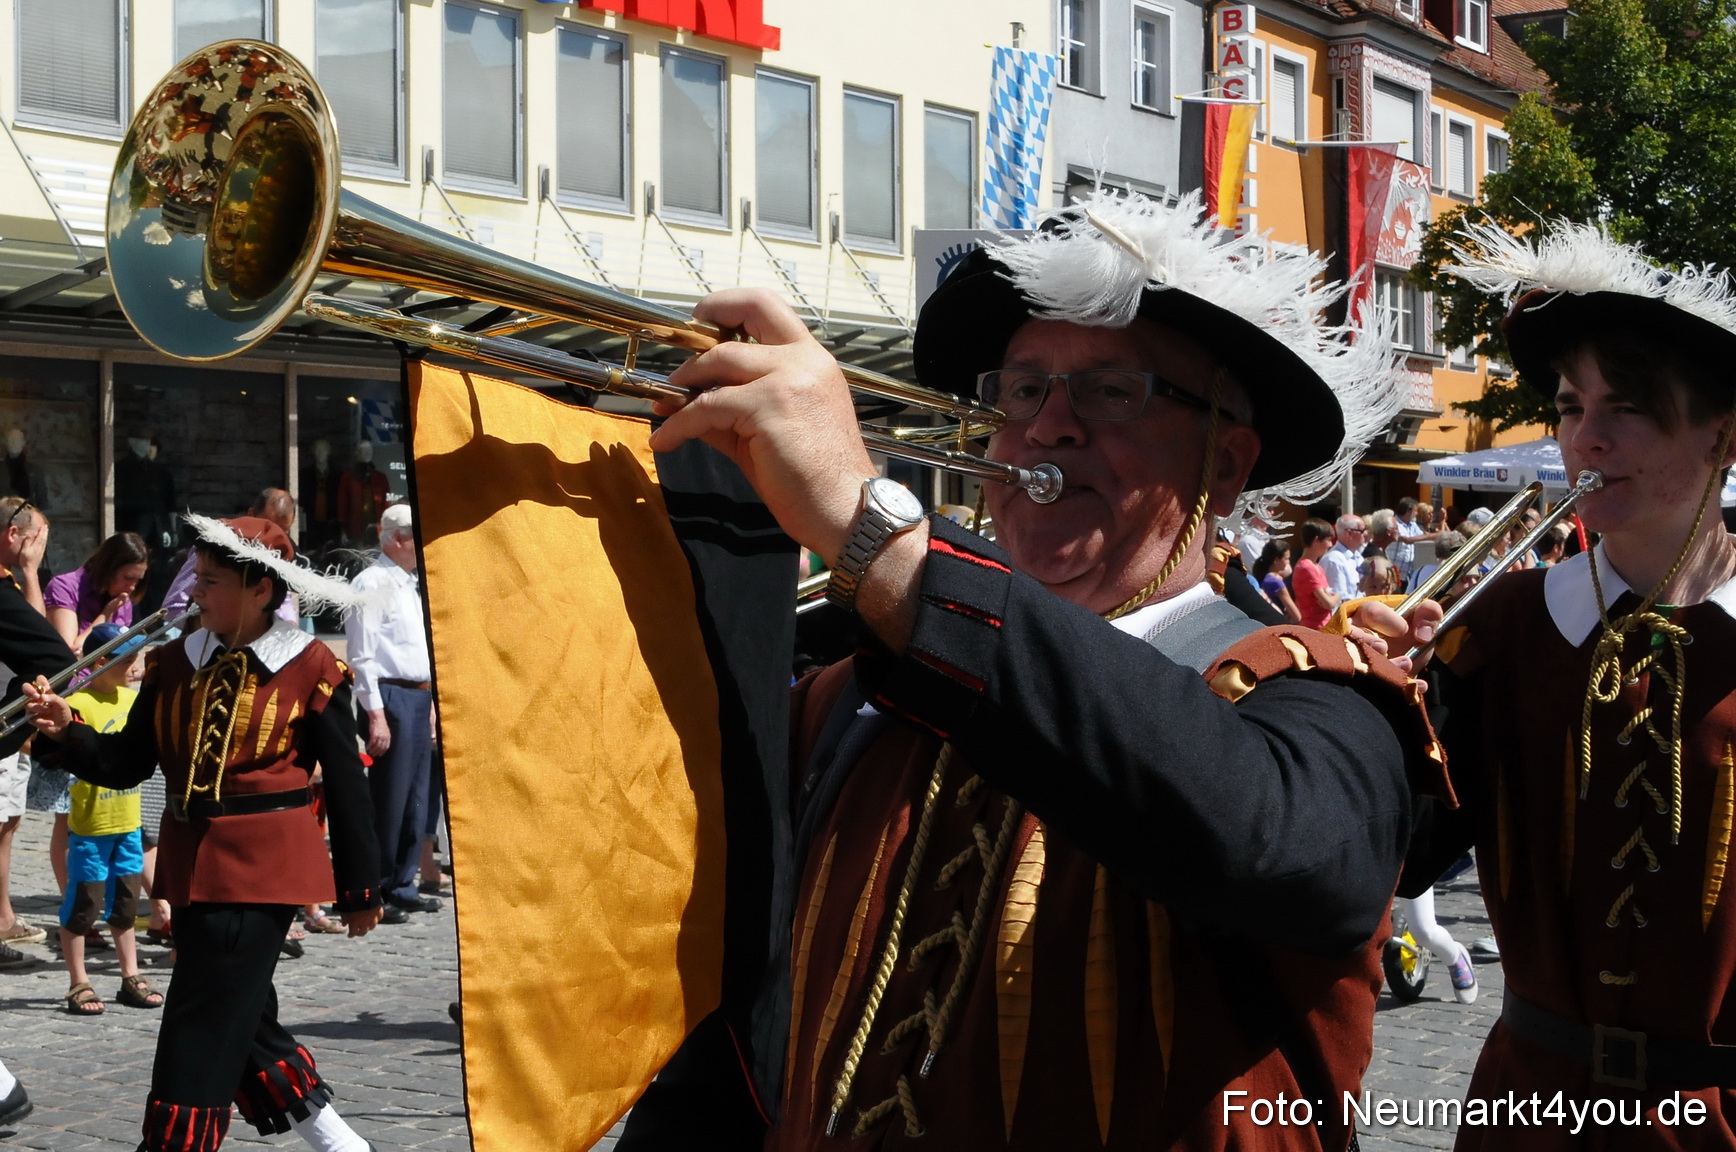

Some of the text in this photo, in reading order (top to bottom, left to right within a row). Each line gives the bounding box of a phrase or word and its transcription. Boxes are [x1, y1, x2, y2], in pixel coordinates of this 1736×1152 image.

[1434, 466, 1495, 479] Winkler Bräu
[1537, 470, 1566, 481] Winkl
